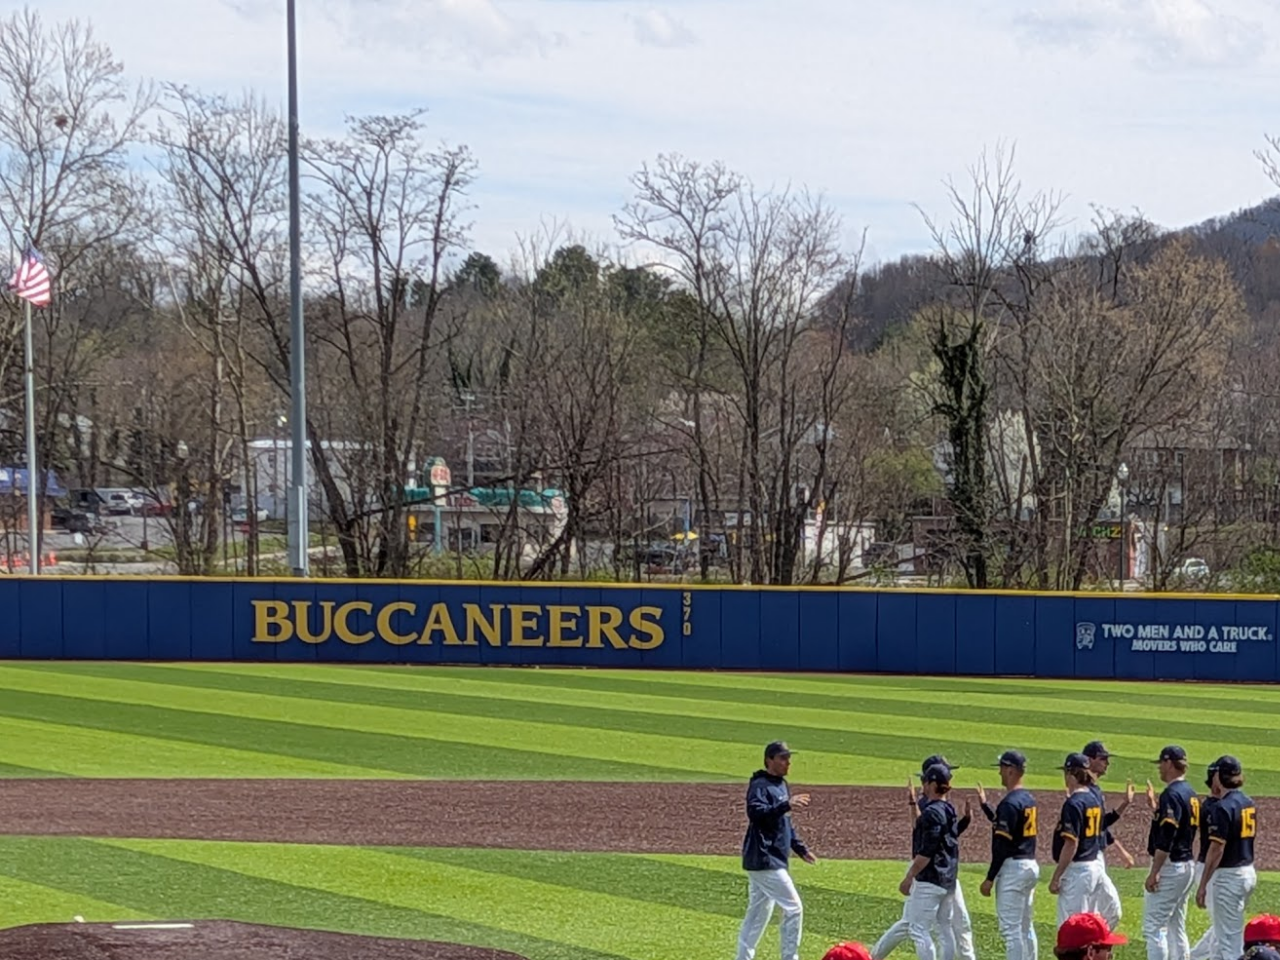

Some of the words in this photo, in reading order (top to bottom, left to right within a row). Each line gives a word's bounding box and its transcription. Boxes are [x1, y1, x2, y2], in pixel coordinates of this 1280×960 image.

[251, 600, 664, 650] BUCCANEERS
[682, 592, 692, 636] 370
[1102, 624, 1134, 638] TWO
[1137, 625, 1169, 639] MEN
[1172, 626, 1204, 640] AND
[1207, 627, 1219, 641] A
[1221, 626, 1268, 641] TRUCK
[1131, 639, 1177, 652] MOVERS
[1179, 641, 1206, 652] WHO
[1208, 641, 1237, 653] CARE
[1086, 807, 1102, 838] 37
[1241, 807, 1256, 838] 15
